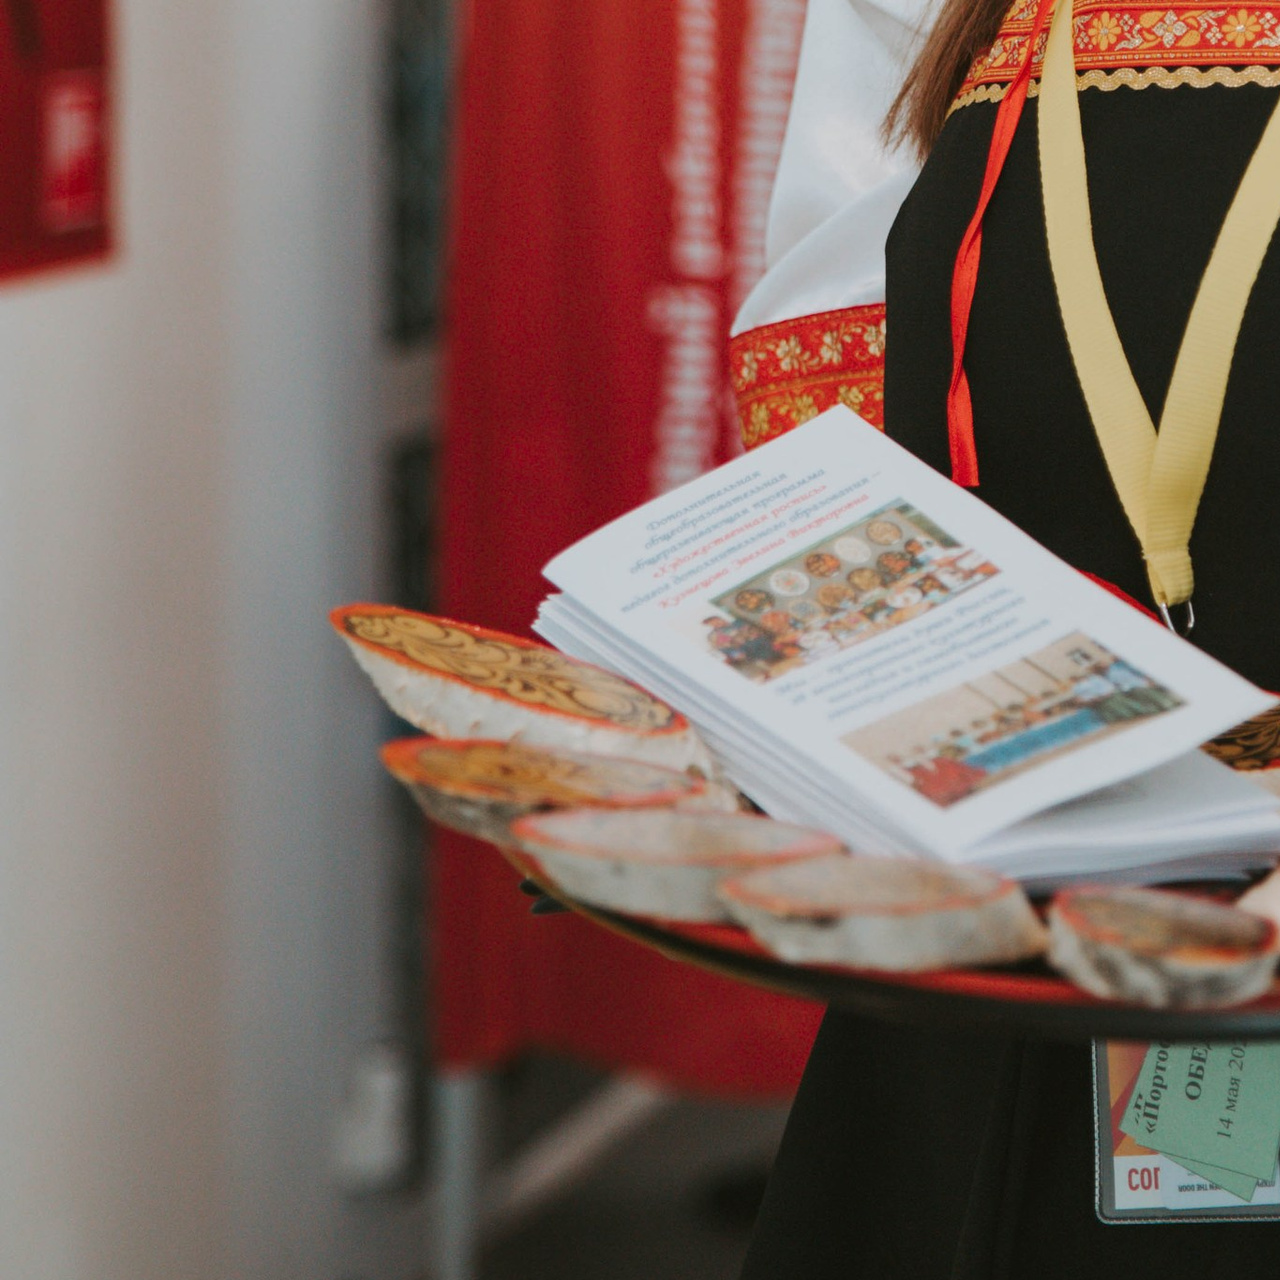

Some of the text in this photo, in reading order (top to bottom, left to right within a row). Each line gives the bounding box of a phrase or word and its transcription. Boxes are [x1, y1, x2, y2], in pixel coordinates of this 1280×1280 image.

[1184, 1042, 1211, 1101] ОБЕ
[1216, 1118, 1233, 1139] 14
[1225, 1077, 1241, 1112] мая
